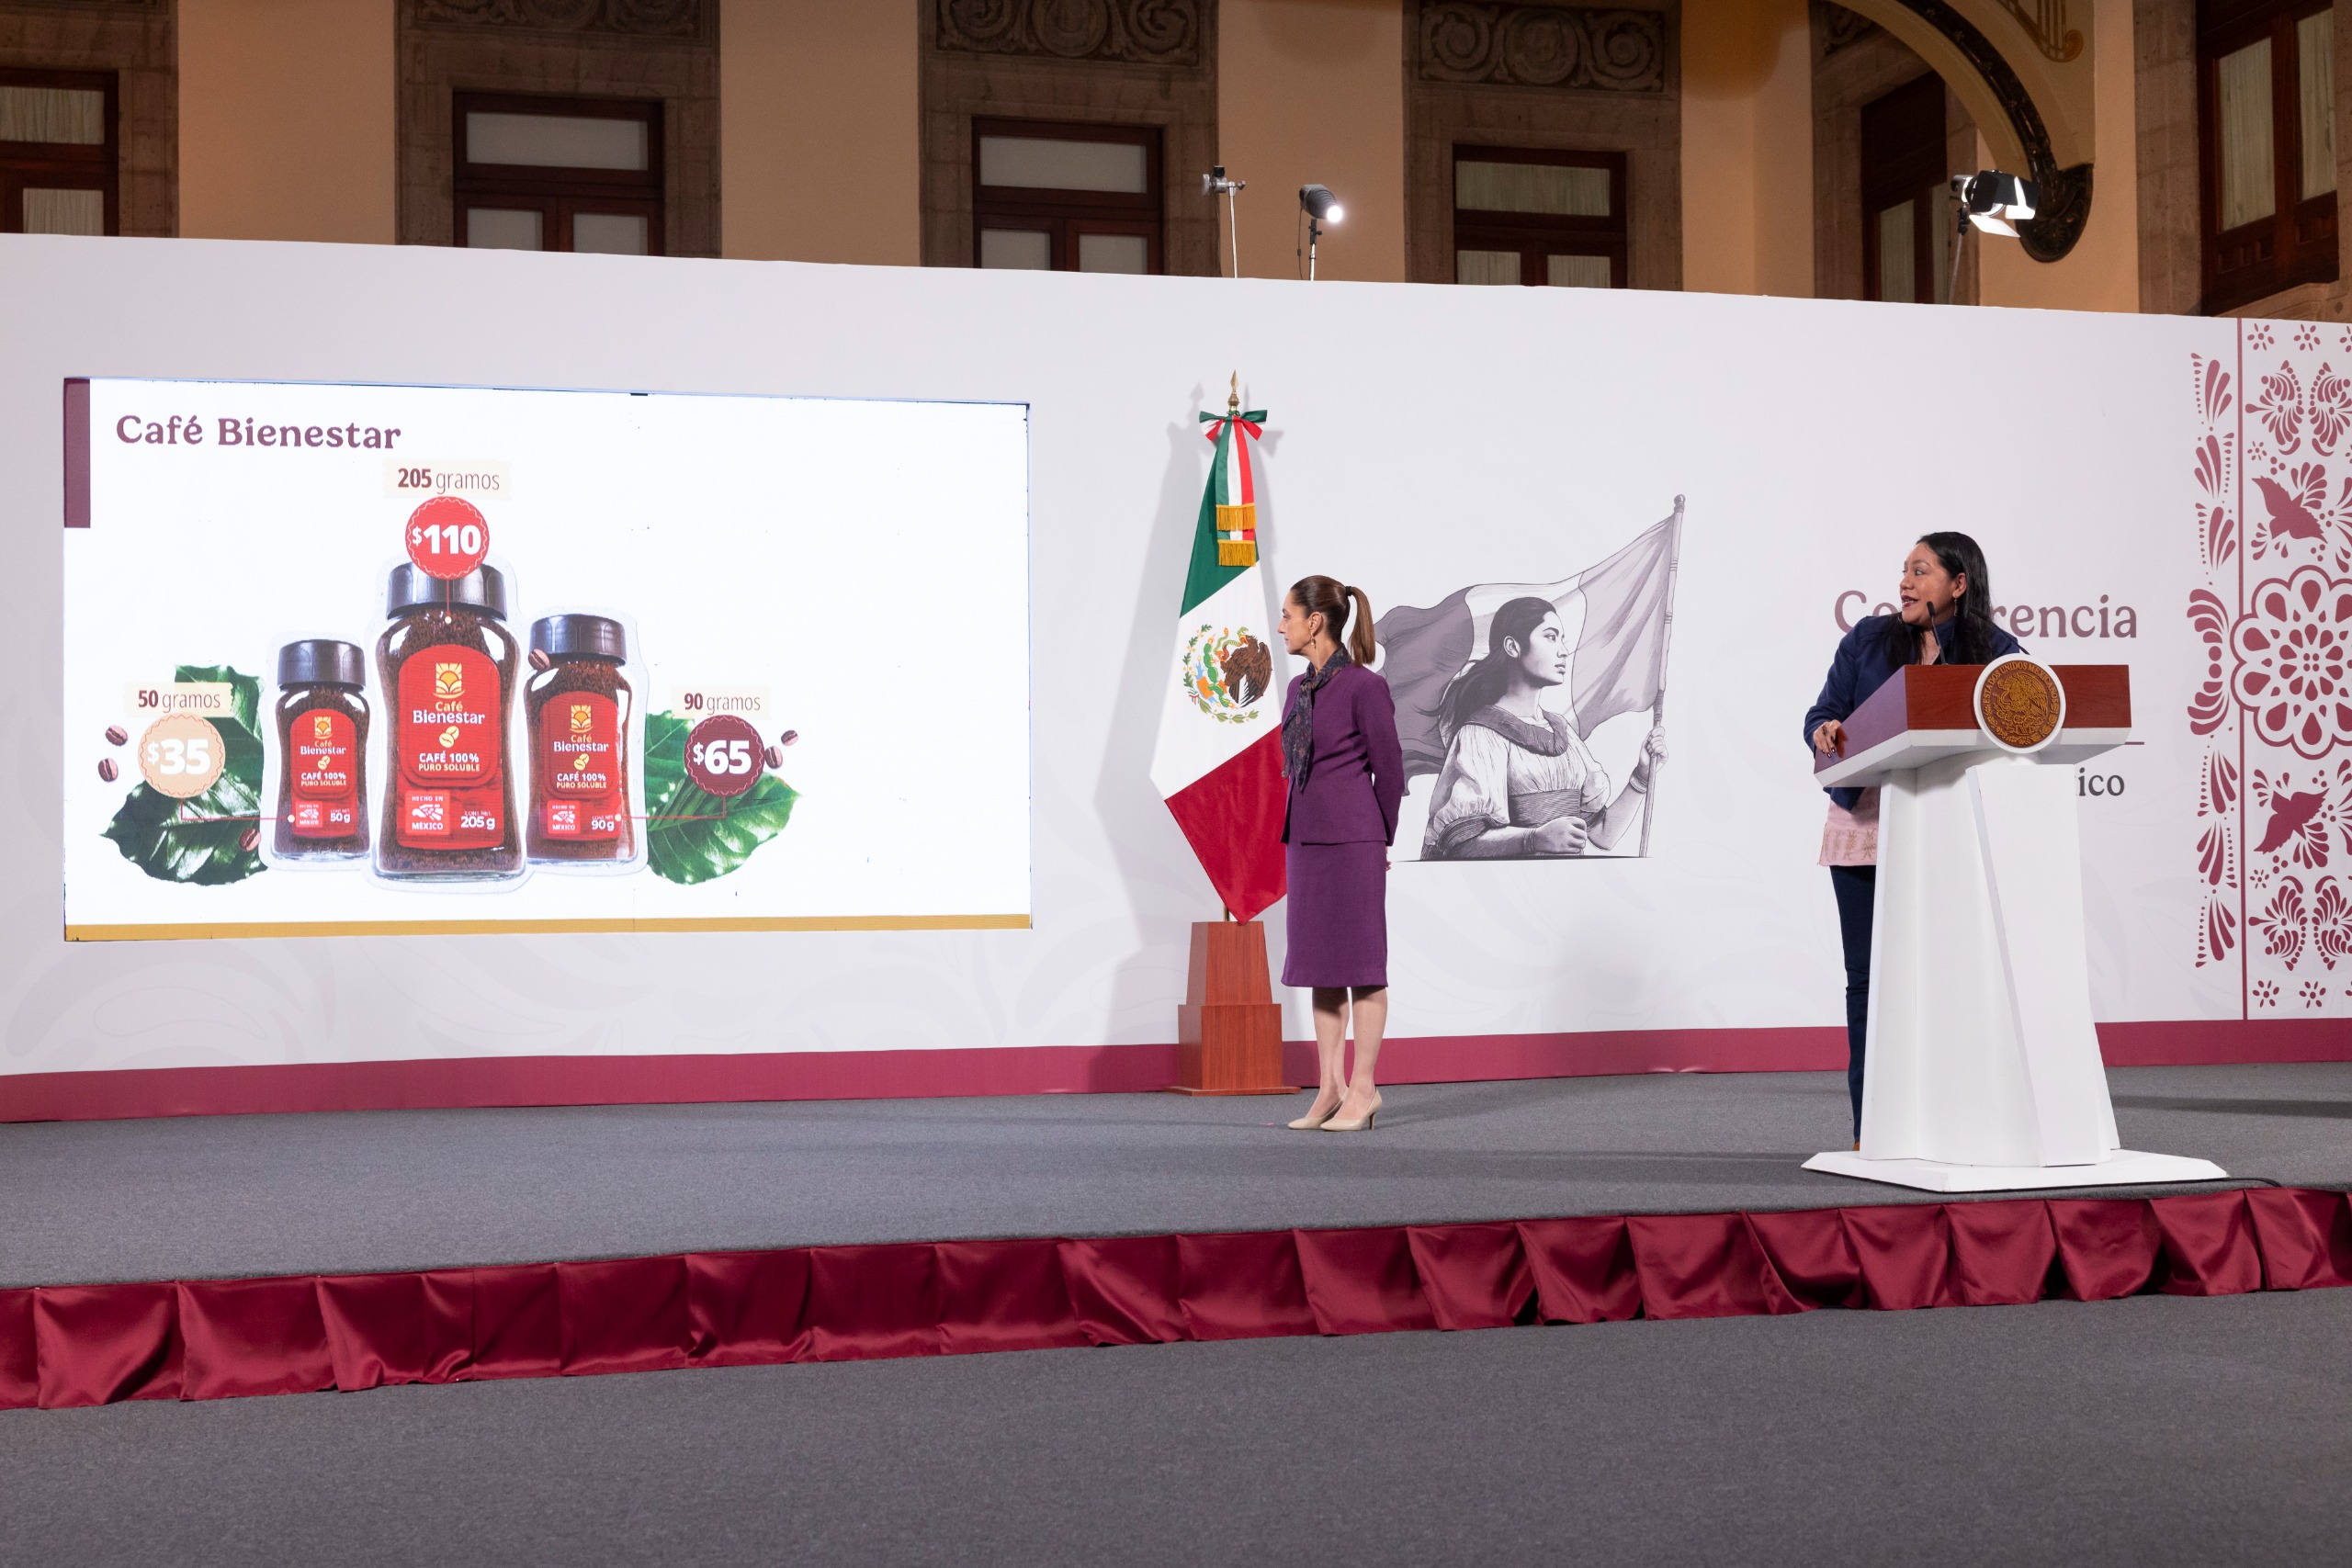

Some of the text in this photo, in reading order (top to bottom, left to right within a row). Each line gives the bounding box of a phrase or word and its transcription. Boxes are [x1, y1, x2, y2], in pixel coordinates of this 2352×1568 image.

[116, 414, 401, 449] Café Bienestar
[397, 468, 500, 494] 205 gramos
[412, 525, 482, 555] $110
[1834, 591, 2137, 638] Crencia
[1983, 661, 2058, 705] ESTADOS UNIDOS MEXICANOS
[138, 690, 220, 714] 50 gramos
[435, 701, 463, 712] Café
[684, 693, 761, 716] 90 gramos
[413, 710, 485, 724] Bienestar
[314, 739, 332, 748] Café
[571, 734, 592, 743] Café
[300, 746, 346, 755] Bienestar
[554, 741, 609, 752] Bienestar
[147, 739, 211, 775] $35
[419, 751, 480, 763] CAFÉ 100%
[693, 739, 752, 775] $65
[418, 763, 481, 772] PURO SOLUBLE
[301, 772, 346, 780] CAFÉ 100%
[557, 772, 606, 782] CAFÉ 100%
[412, 821, 443, 829] MÉXICO
